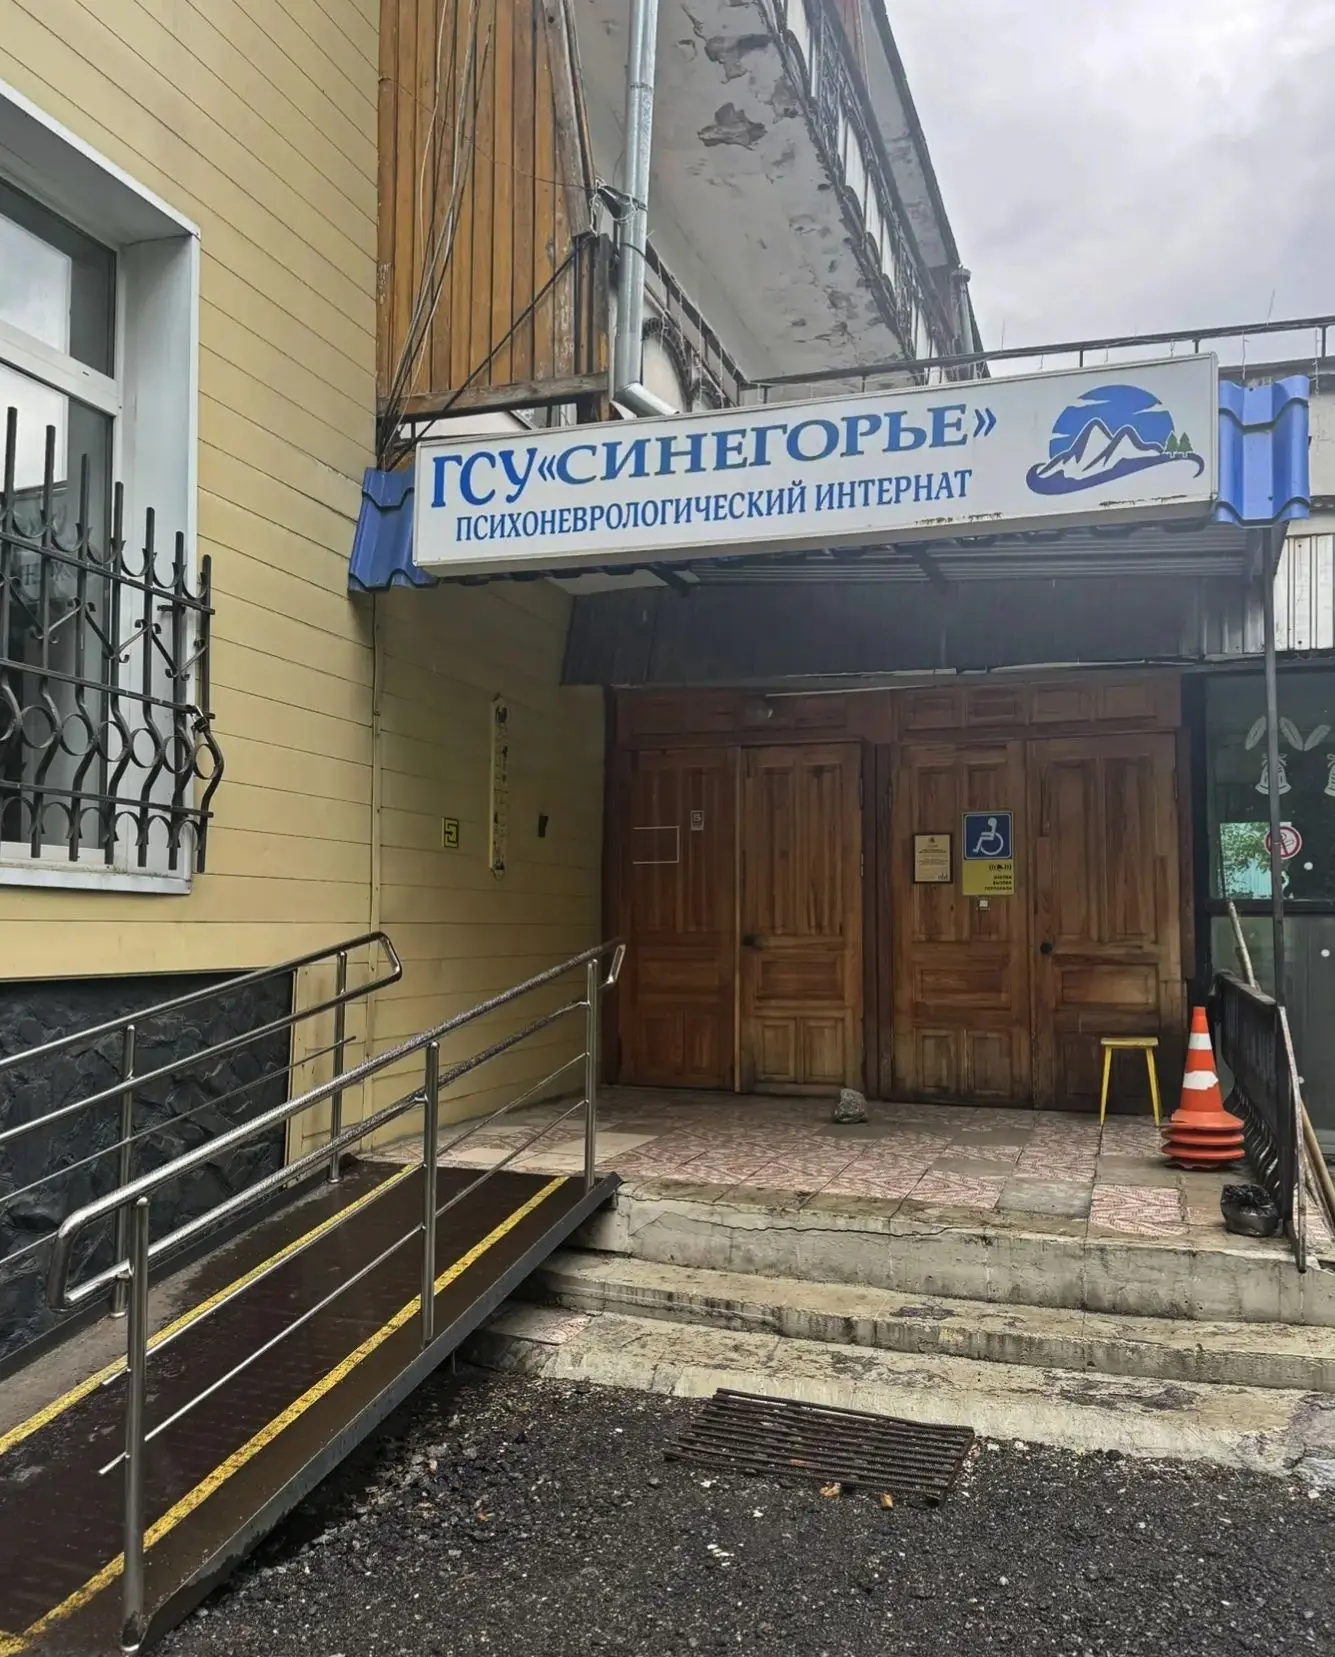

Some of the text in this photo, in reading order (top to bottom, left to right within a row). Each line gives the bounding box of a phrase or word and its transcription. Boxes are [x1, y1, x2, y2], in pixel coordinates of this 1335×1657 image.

[431, 404, 997, 508] ГСУ «СИНЕГОРЬЕ»
[456, 469, 972, 541] ПСИХОНЕВРОЛОГИЧЕСКИЙ ИНТЕРНАТ
